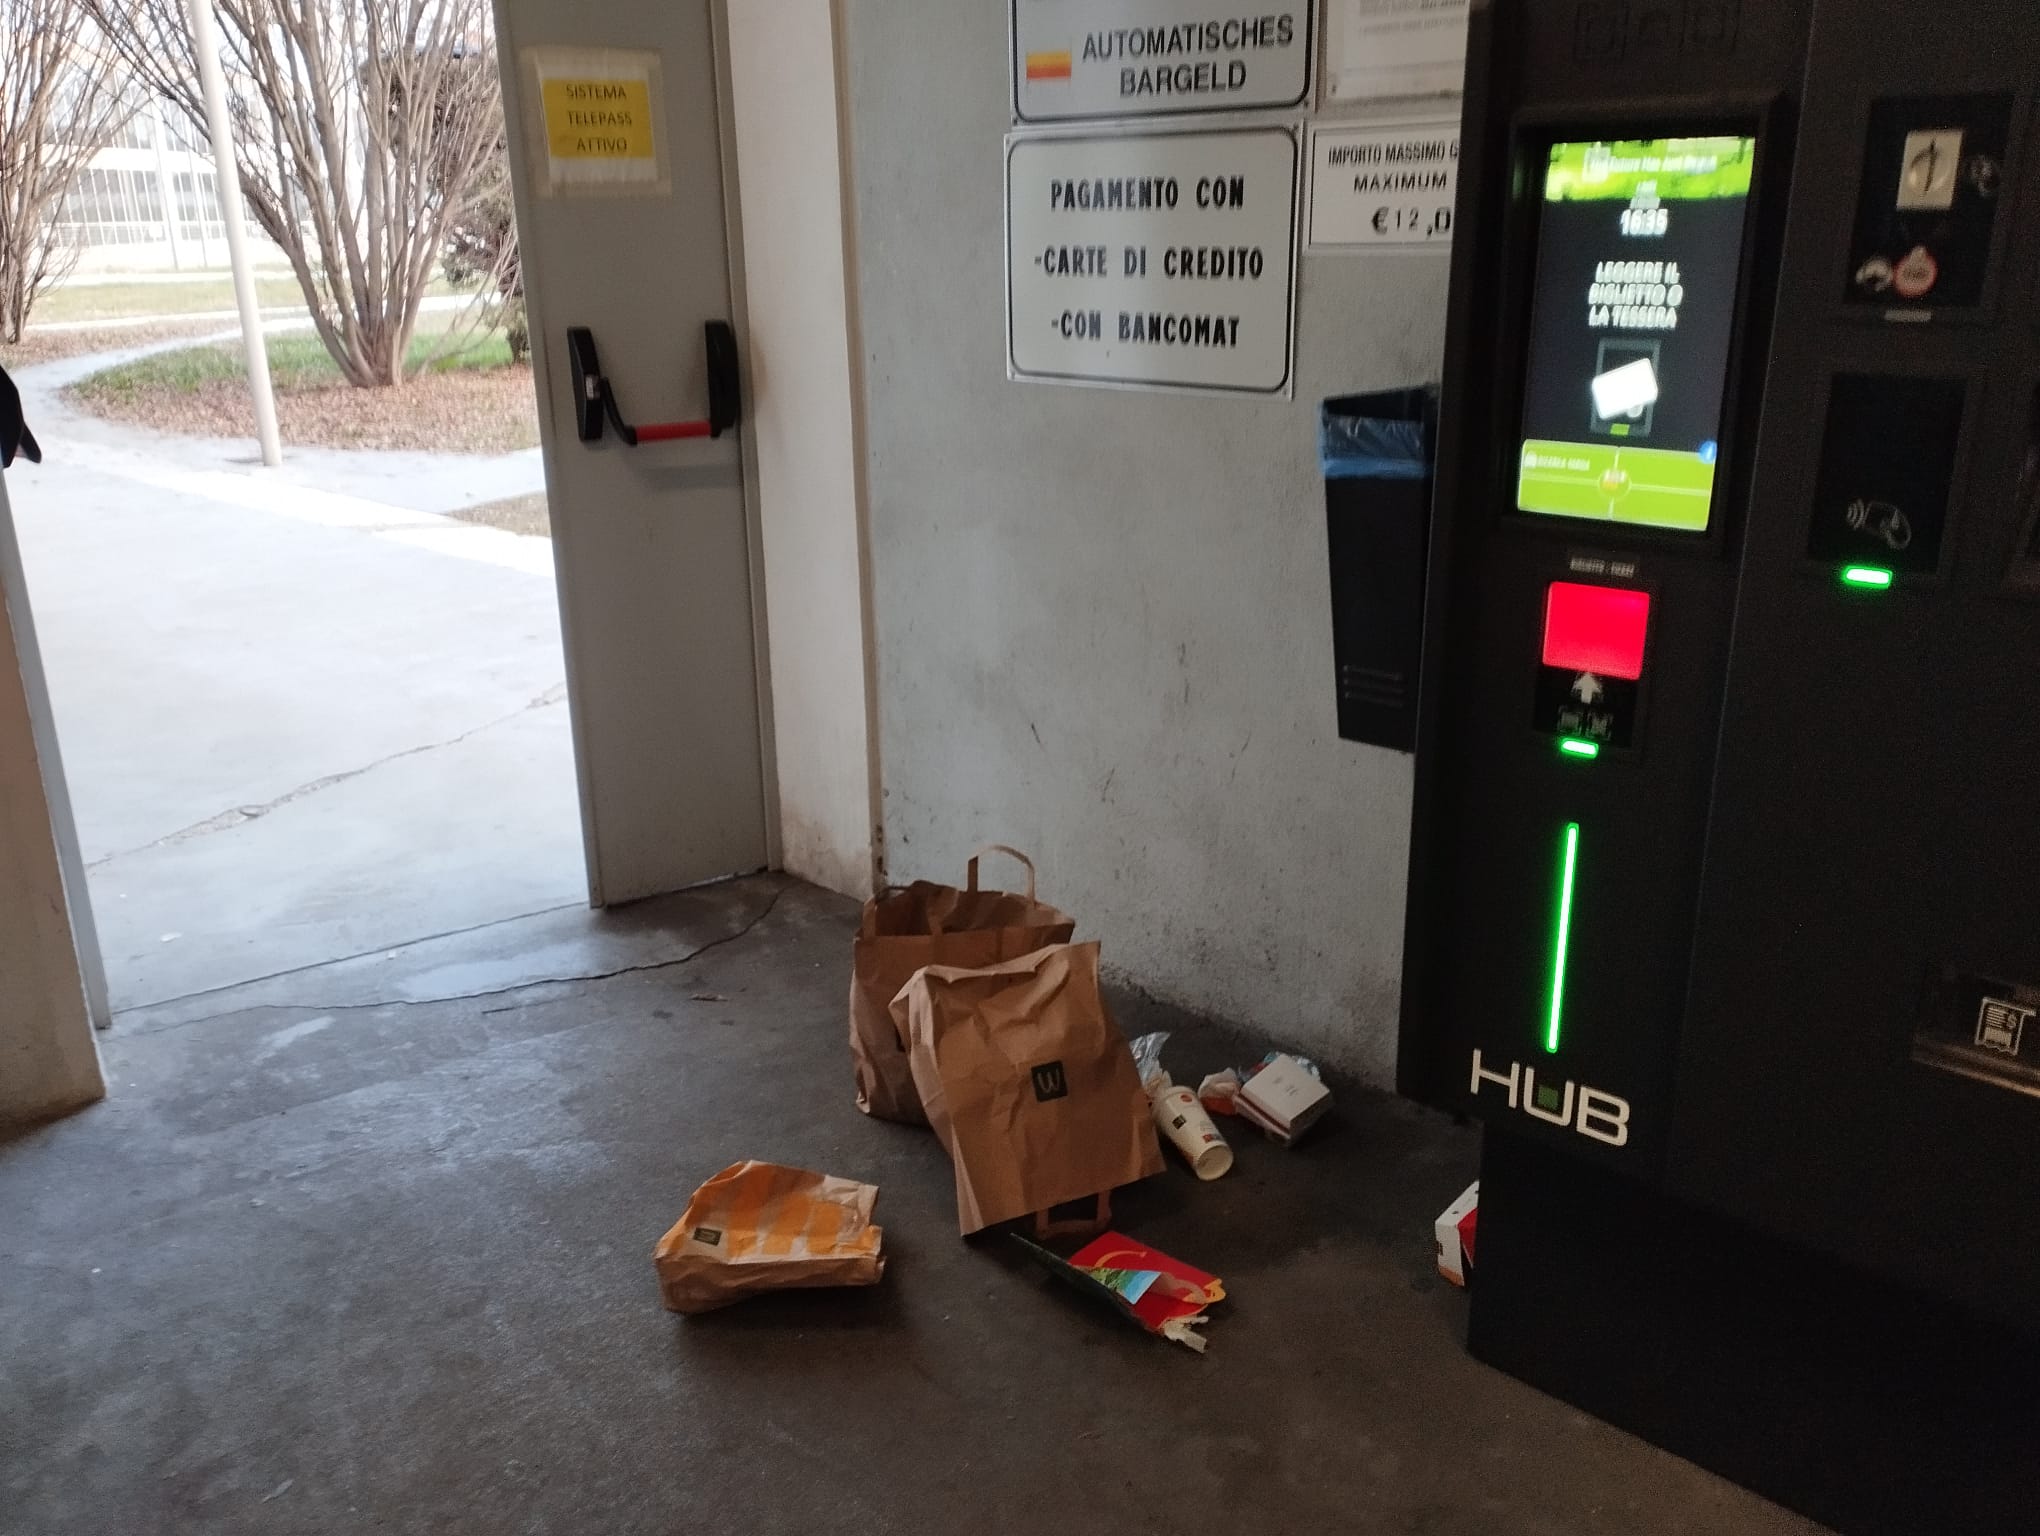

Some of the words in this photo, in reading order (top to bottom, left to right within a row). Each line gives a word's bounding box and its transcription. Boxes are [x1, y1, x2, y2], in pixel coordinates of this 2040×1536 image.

[1083, 14, 1293, 61] AUTOMATISCHES
[566, 84, 627, 99] SISTEMA
[1120, 60, 1247, 97] BARGELD
[567, 111, 632, 126] TELEPASS
[576, 137, 628, 152] ATTIVO
[1328, 144, 1382, 167] IMPORTO
[1385, 141, 1446, 164] MASSIMO
[1050, 176, 1179, 211] PAGAMENTO
[1196, 174, 1244, 210] CON
[1354, 170, 1447, 194] MAXIMUM
[1124, 246, 1147, 278] DI
[1163, 246, 1264, 279] CREDITO
[1118, 311, 1240, 348] BANCOMAT
[1470, 1048, 1630, 1147] HUB
